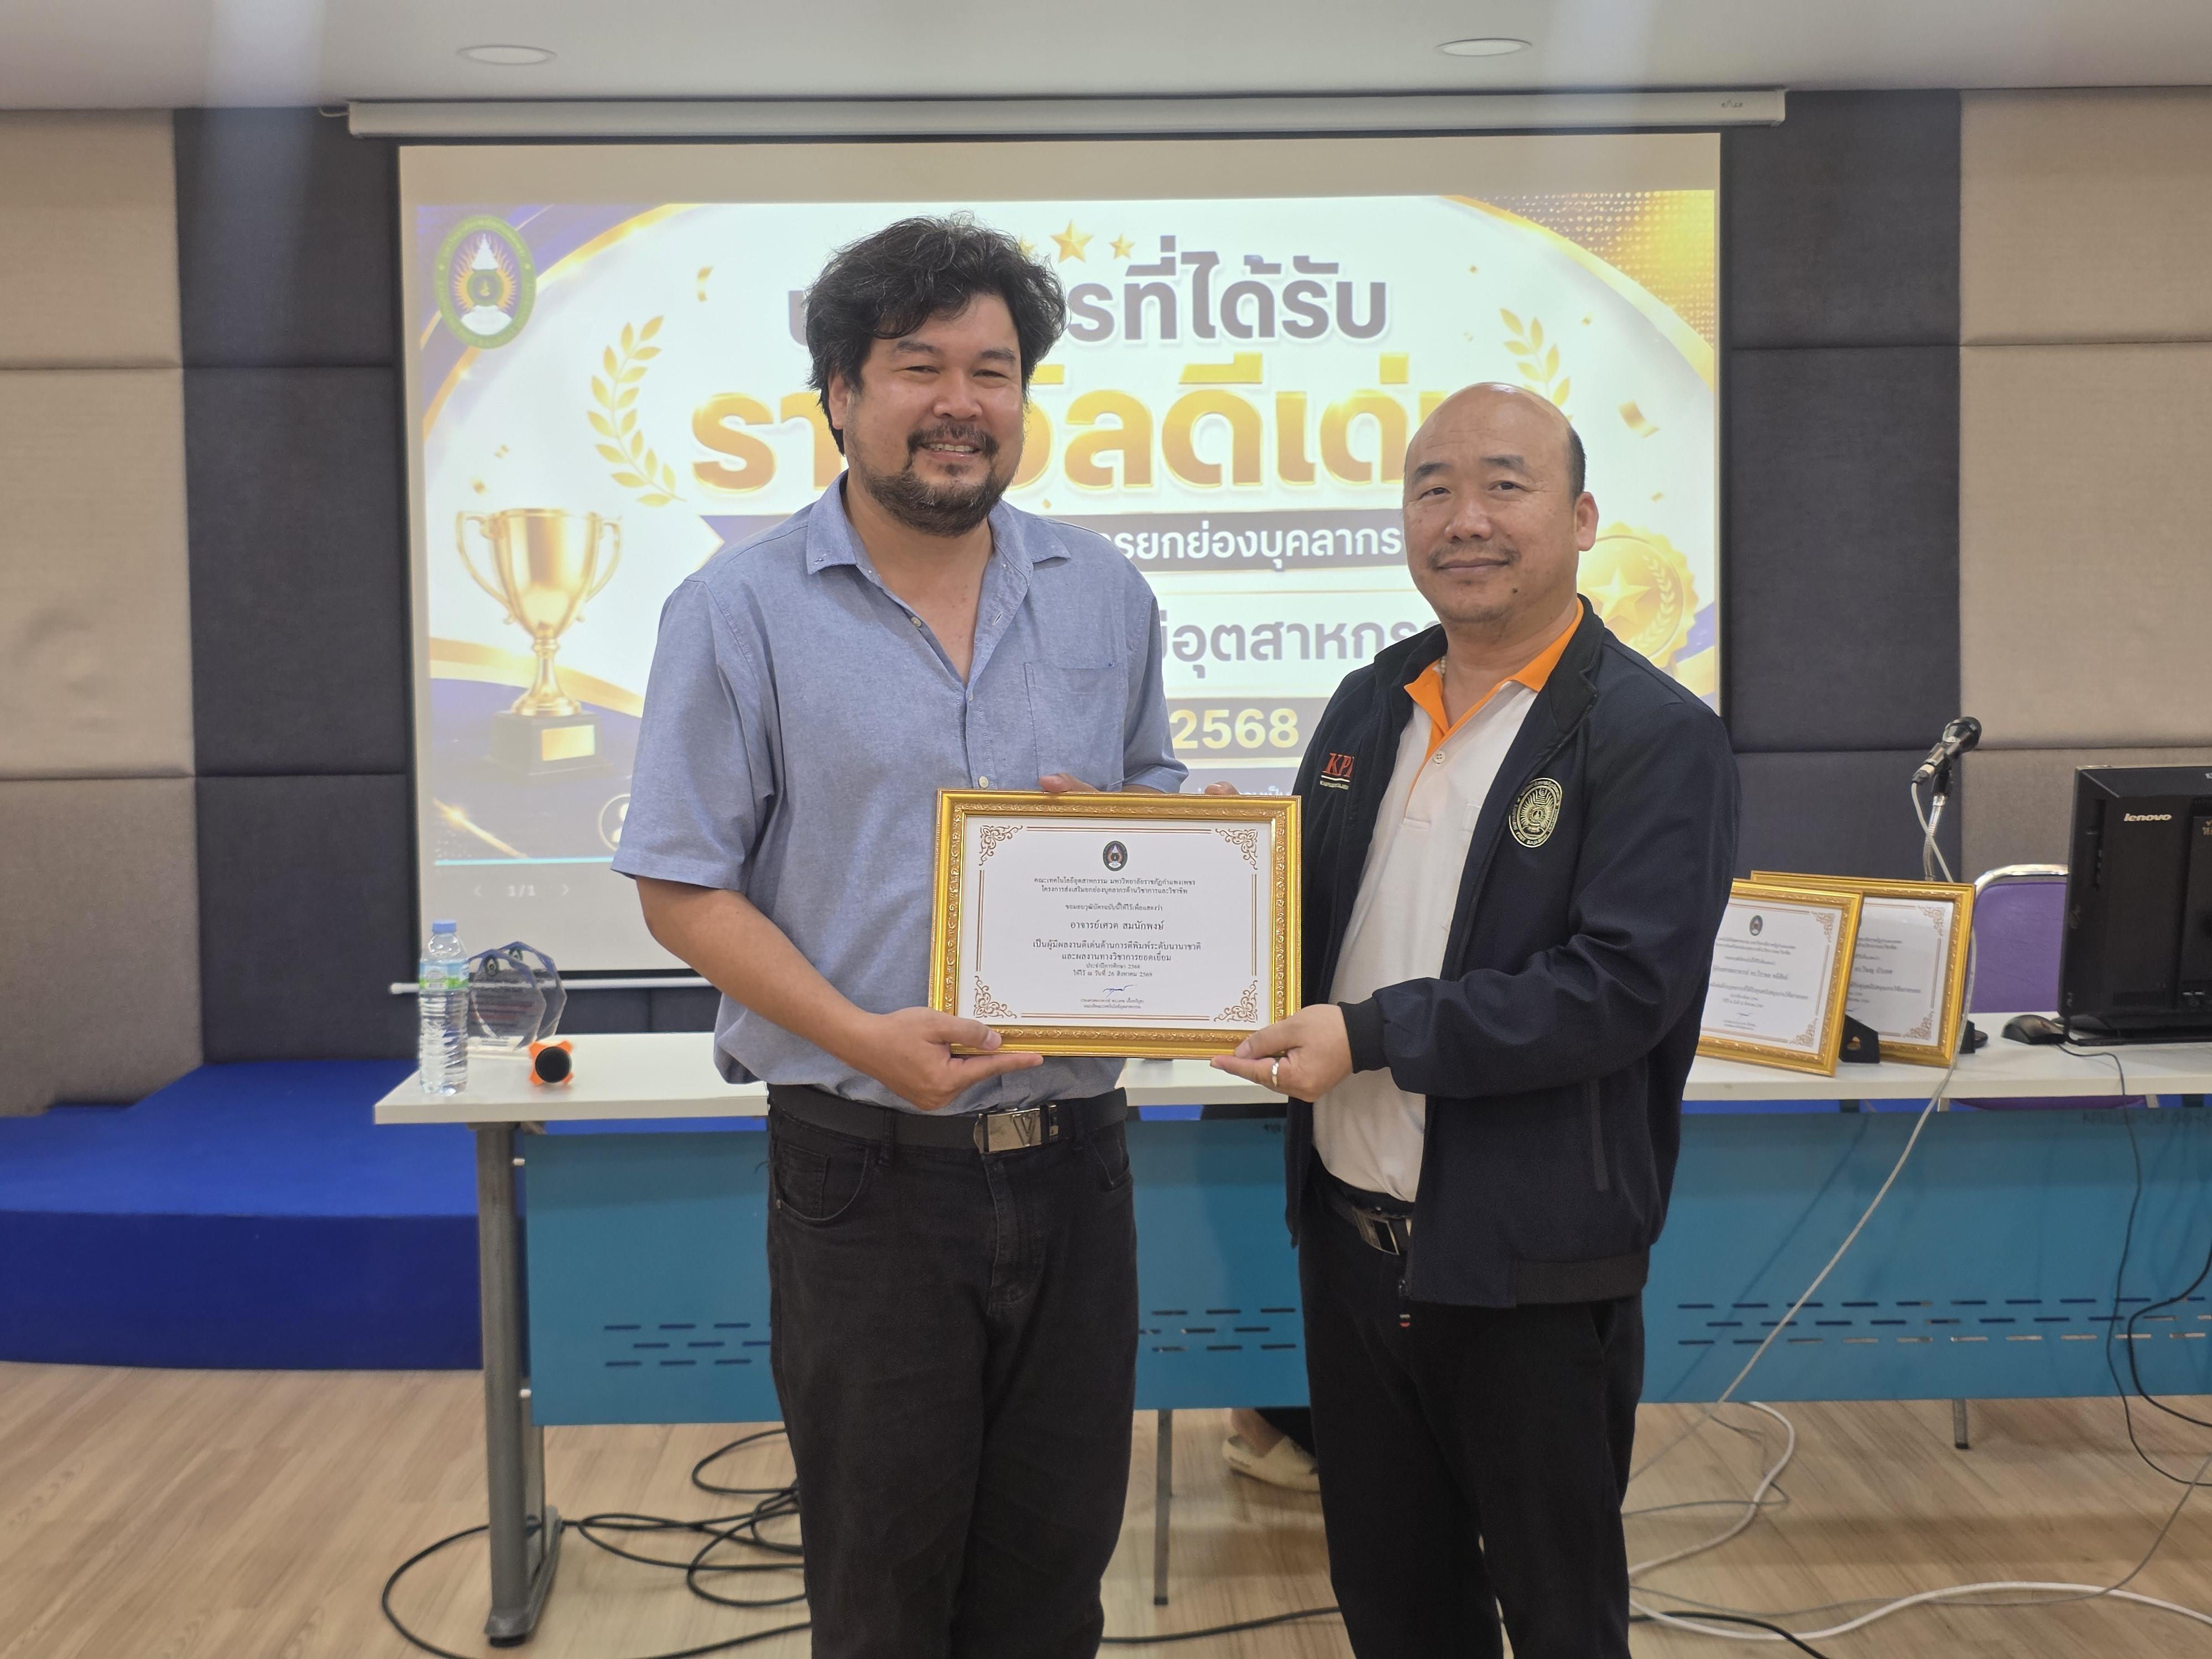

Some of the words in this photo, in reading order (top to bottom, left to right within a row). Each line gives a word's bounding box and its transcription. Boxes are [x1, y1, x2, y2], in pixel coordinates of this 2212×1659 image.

[1100, 520, 1402, 569] รยกย่องบุคลากร
[1170, 708, 1299, 749] 2568
[2124, 813, 2172, 822] lenovo
[508, 885, 536, 897] 1/1
[1061, 951, 1172, 962] และผลงานทางวิชาการยอดเยี่ยม
